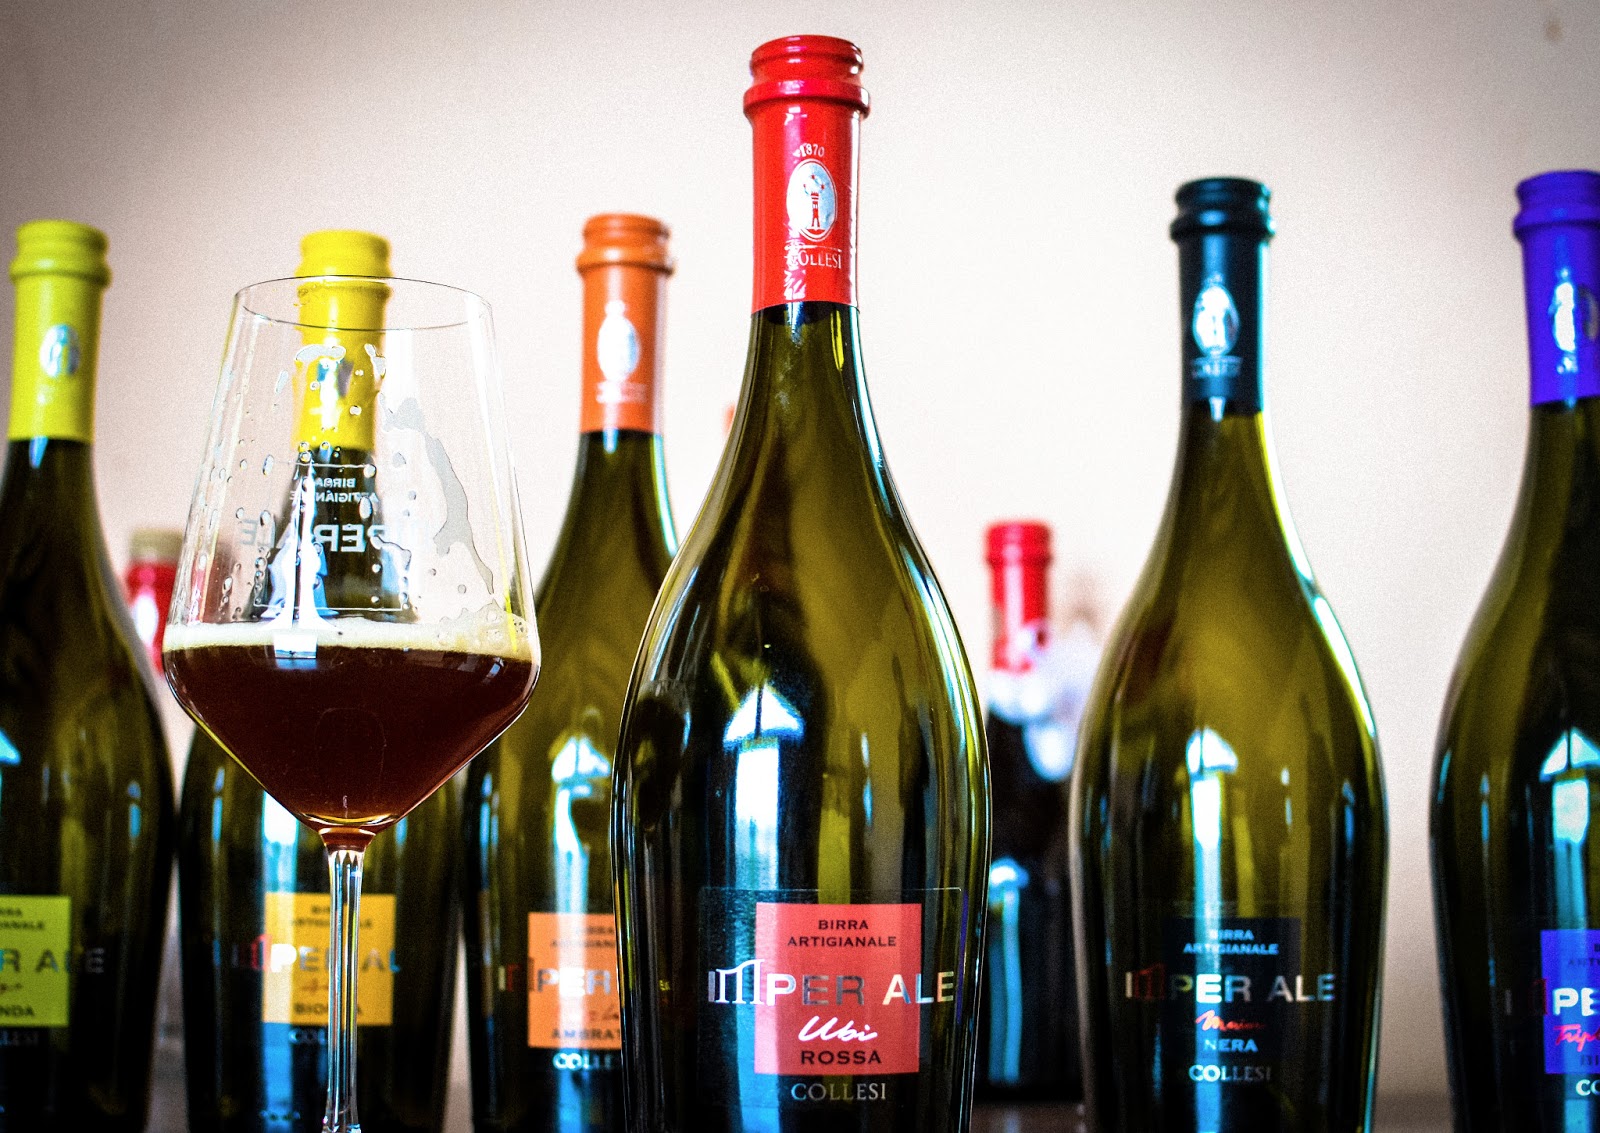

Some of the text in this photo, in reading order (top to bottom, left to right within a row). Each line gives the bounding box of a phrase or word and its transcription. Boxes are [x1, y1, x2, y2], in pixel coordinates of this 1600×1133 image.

[799, 142, 825, 158] 1870
[817, 919, 869, 930] BIRRA
[787, 935, 897, 947] ARTIGIANALE
[1208, 929, 1255, 941] BIRRA
[1183, 943, 1280, 955] ARTIGIANALE
[882, 971, 954, 1005] ALE
[1266, 973, 1336, 1003] ALE
[798, 1015, 878, 1042] Ubi
[1203, 1038, 1259, 1052] NERA
[801, 1051, 882, 1065] ROSSA
[1188, 1064, 1272, 1083] COLLESI
[790, 1083, 886, 1101] COLLESI
